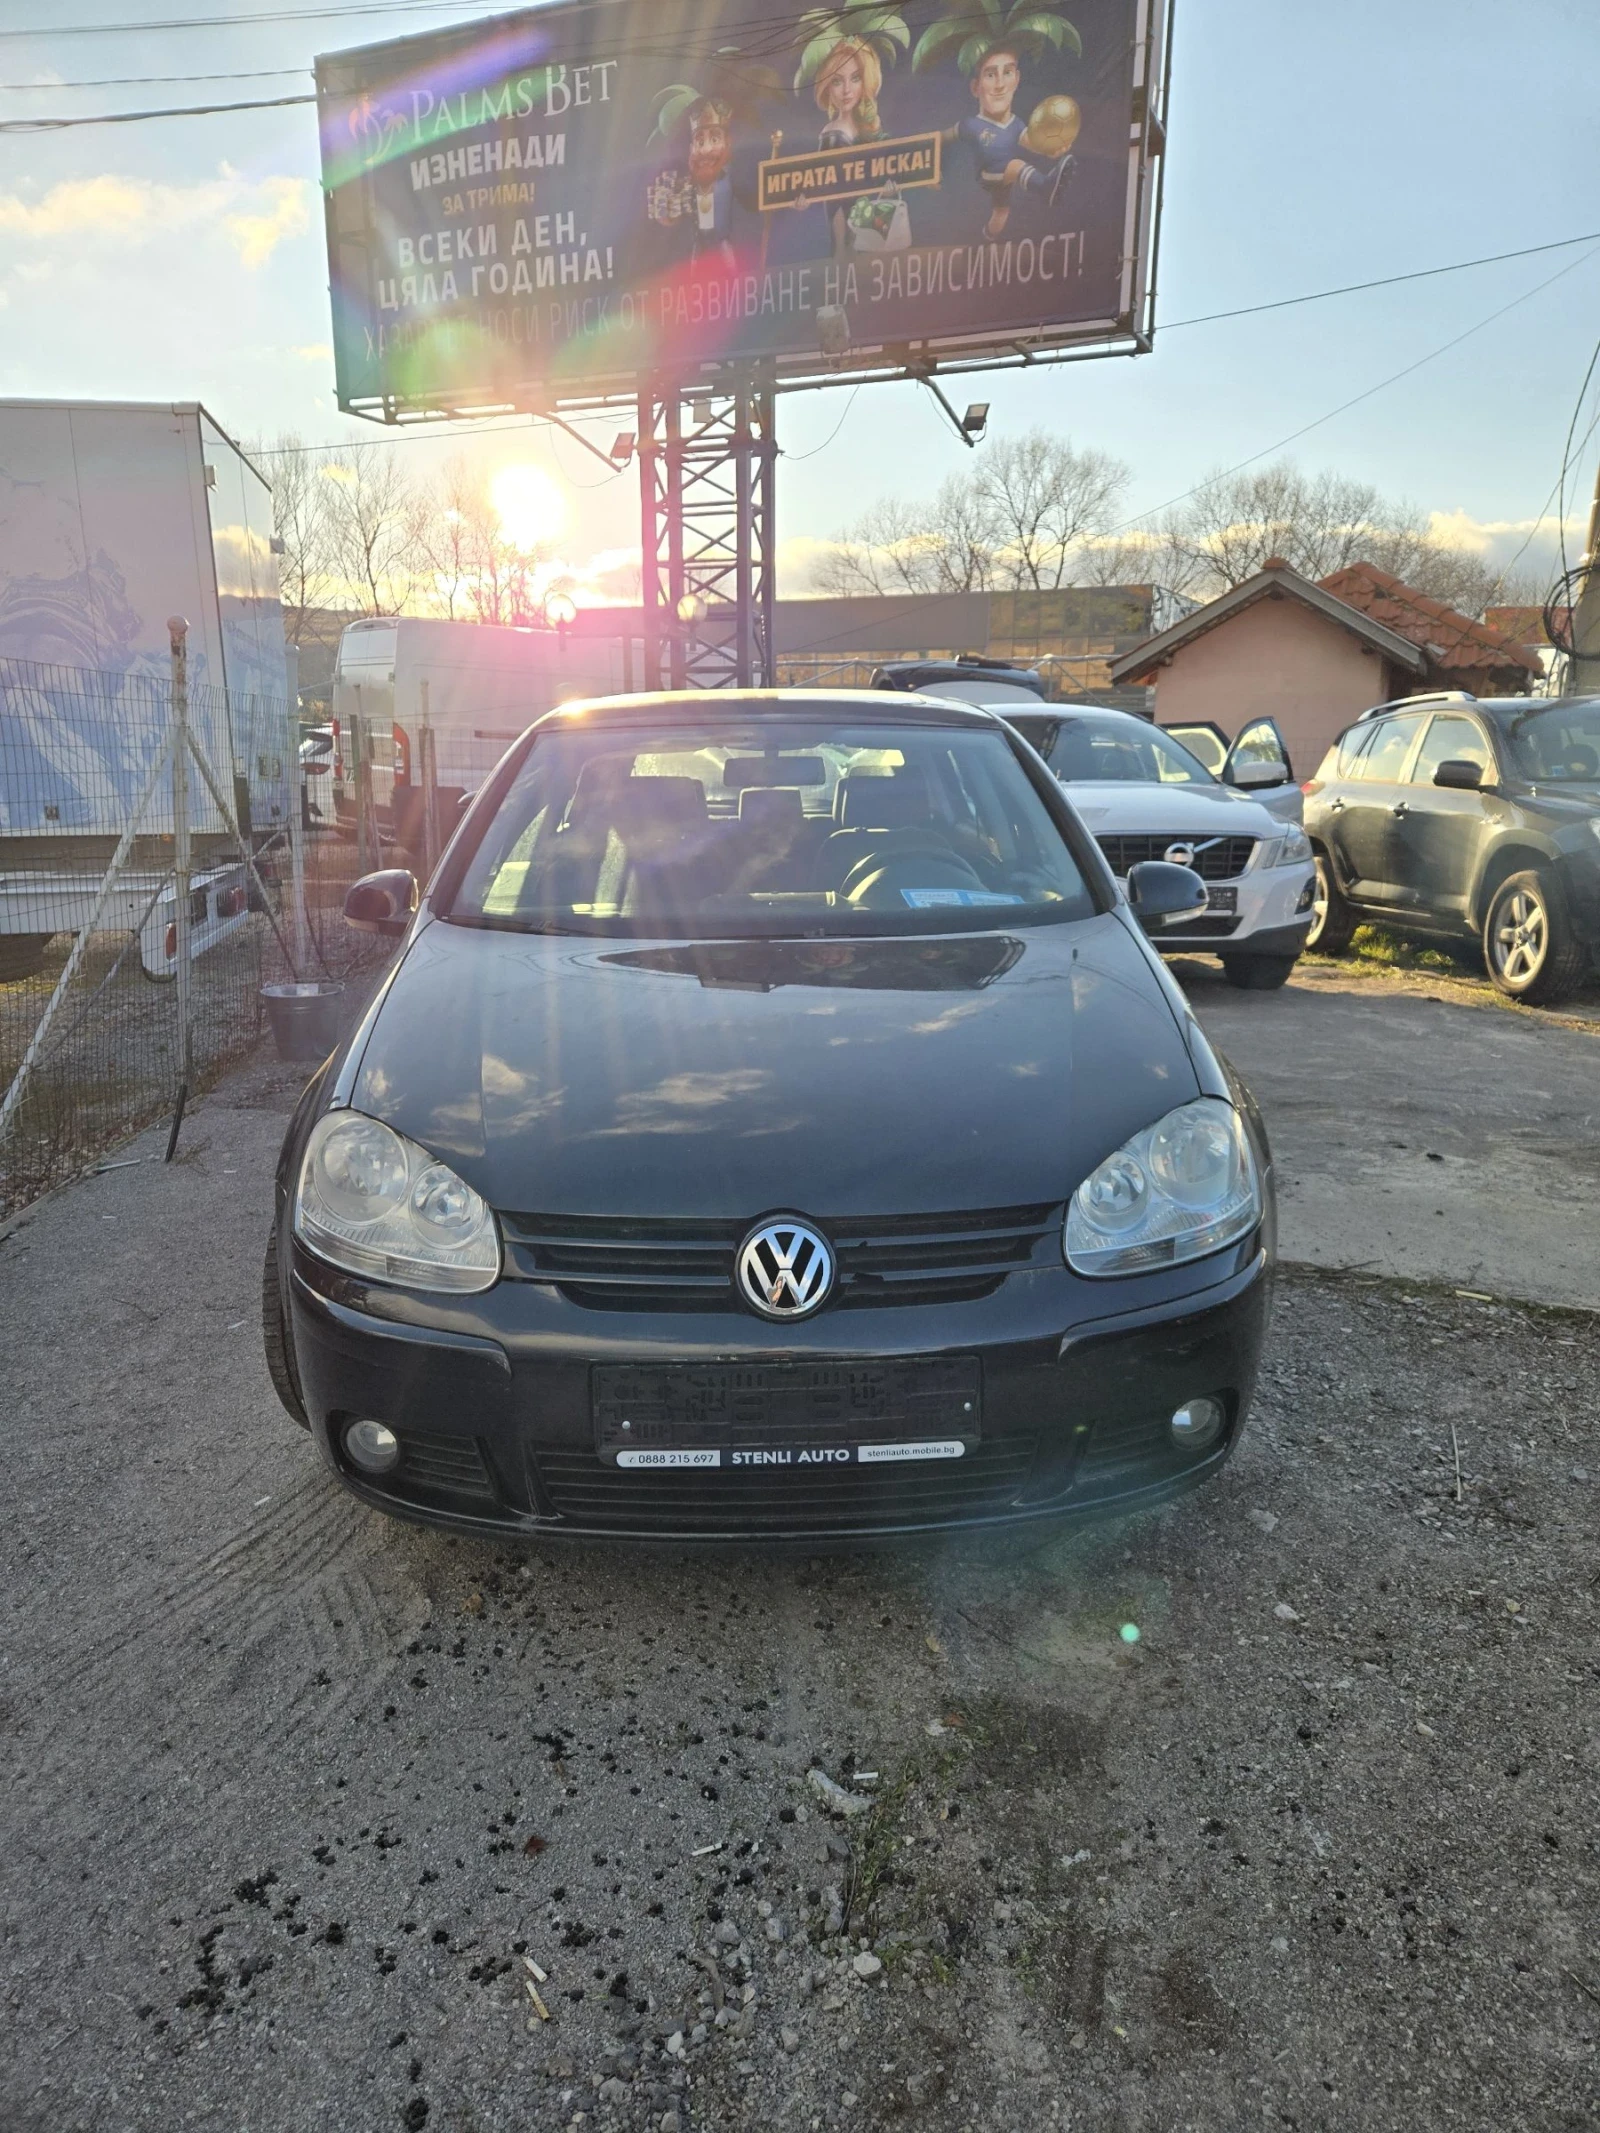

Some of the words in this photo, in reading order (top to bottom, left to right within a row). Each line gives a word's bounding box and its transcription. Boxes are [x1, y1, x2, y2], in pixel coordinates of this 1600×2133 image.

[410, 77, 533, 144] PALMS
[544, 60, 617, 118] BET
[410, 133, 567, 191] ИЗНЕНАДИ
[767, 165, 838, 194] ИГРАТА
[842, 162, 866, 183] ТЕ
[871, 151, 932, 177] ИСКА!
[442, 193, 466, 216] ЗА
[467, 183, 536, 211] ТРИМА!
[398, 222, 497, 268] ВСЕКИ
[511, 210, 588, 255] ДЕН,
[378, 271, 459, 312] ЦЯЛА
[471, 246, 615, 296] ГОДИНА!
[479, 303, 541, 348] НОСИ
[551, 296, 610, 338] РИСК
[620, 290, 649, 331] ОТ
[660, 269, 812, 328] РАЗВИВАНЕ
[824, 262, 859, 306] НА
[870, 230, 1086, 302] ЗАВИСИМОСТ!
[638, 1454, 666, 1464] 0888
[669, 1454, 690, 1464] 215
[693, 1454, 714, 1464] 697
[731, 1451, 791, 1465] STENLI
[798, 1449, 850, 1463] AUTO
[867, 1446, 955, 1458] stenliauto.mobile.bg
